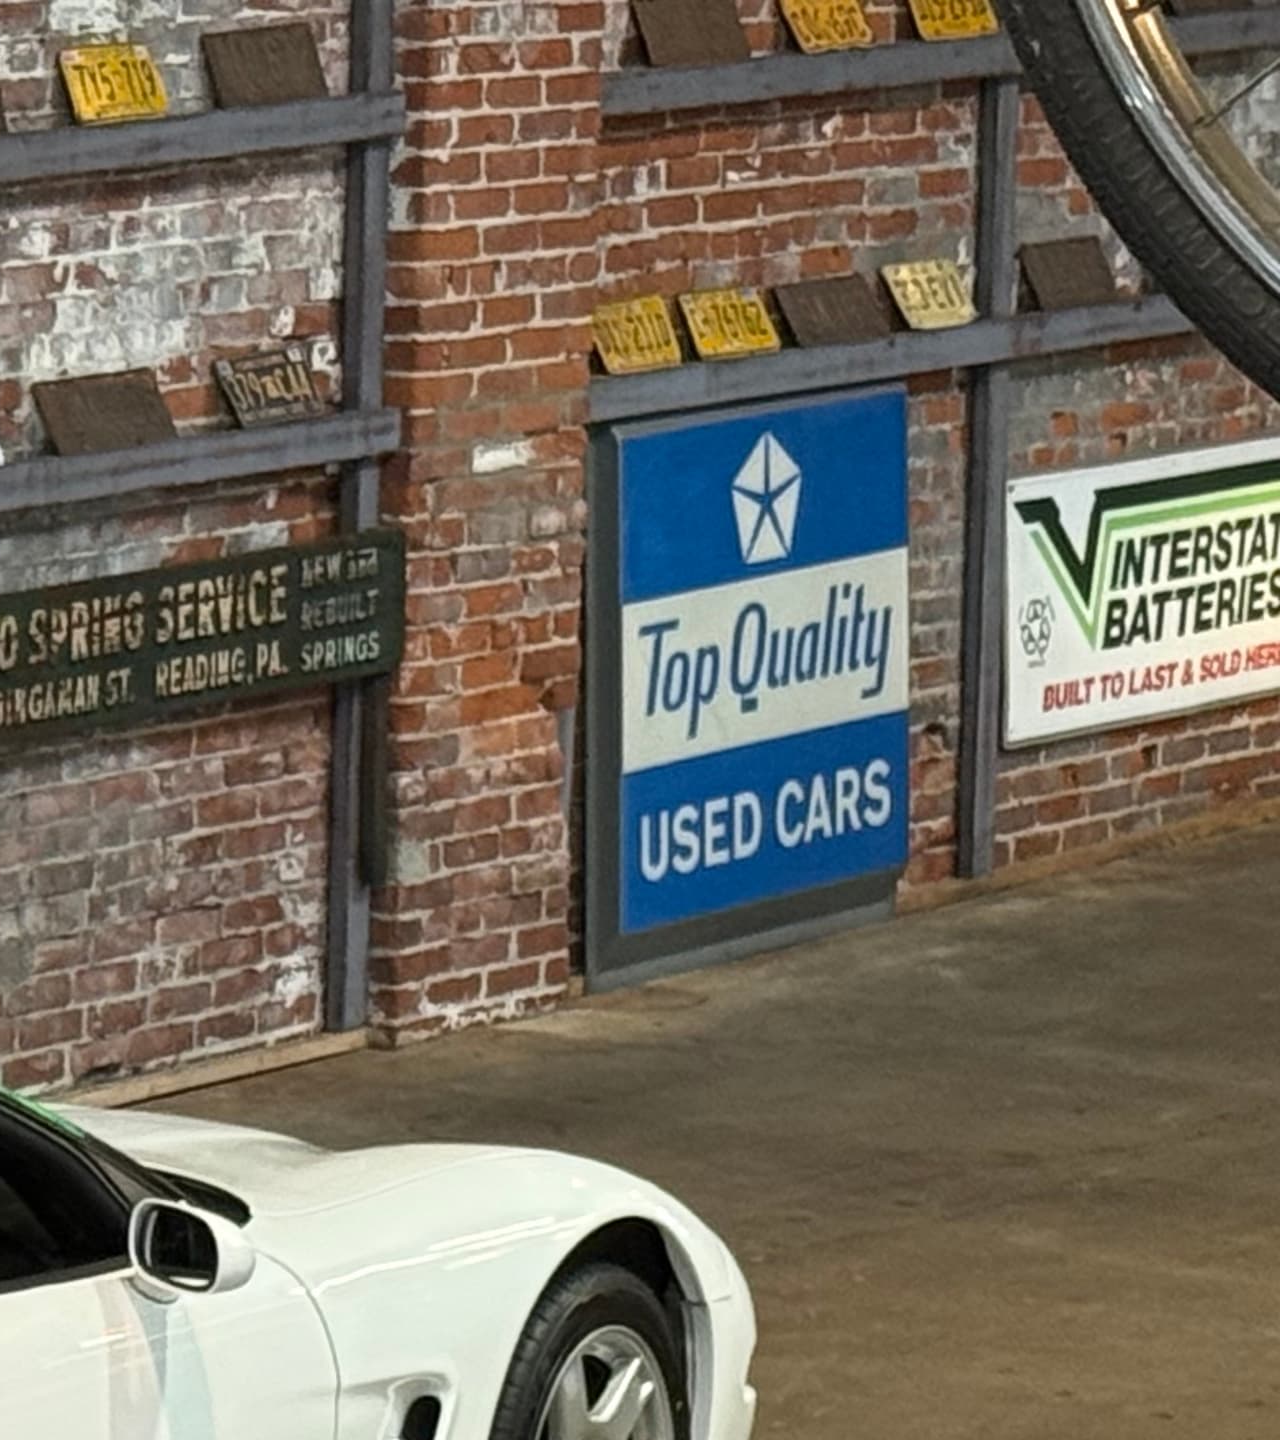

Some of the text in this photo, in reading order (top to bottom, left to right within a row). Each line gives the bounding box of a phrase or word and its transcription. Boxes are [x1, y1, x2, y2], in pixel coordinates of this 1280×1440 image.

[27, 591, 145, 665] SPRING
[155, 565, 289, 644] SERVICE
[1101, 567, 1280, 650] BATTERIES
[256, 641, 289, 678] PA.
[300, 631, 380, 672] SPRINGS
[639, 582, 892, 739] Top Quality
[1042, 676, 1095, 712] BUILT
[1100, 671, 1125, 701] TO
[1130, 660, 1179, 695] LAST
[1181, 655, 1194, 686] &
[1199, 649, 1242, 683] SOLD
[641, 758, 892, 882] USED CARS
